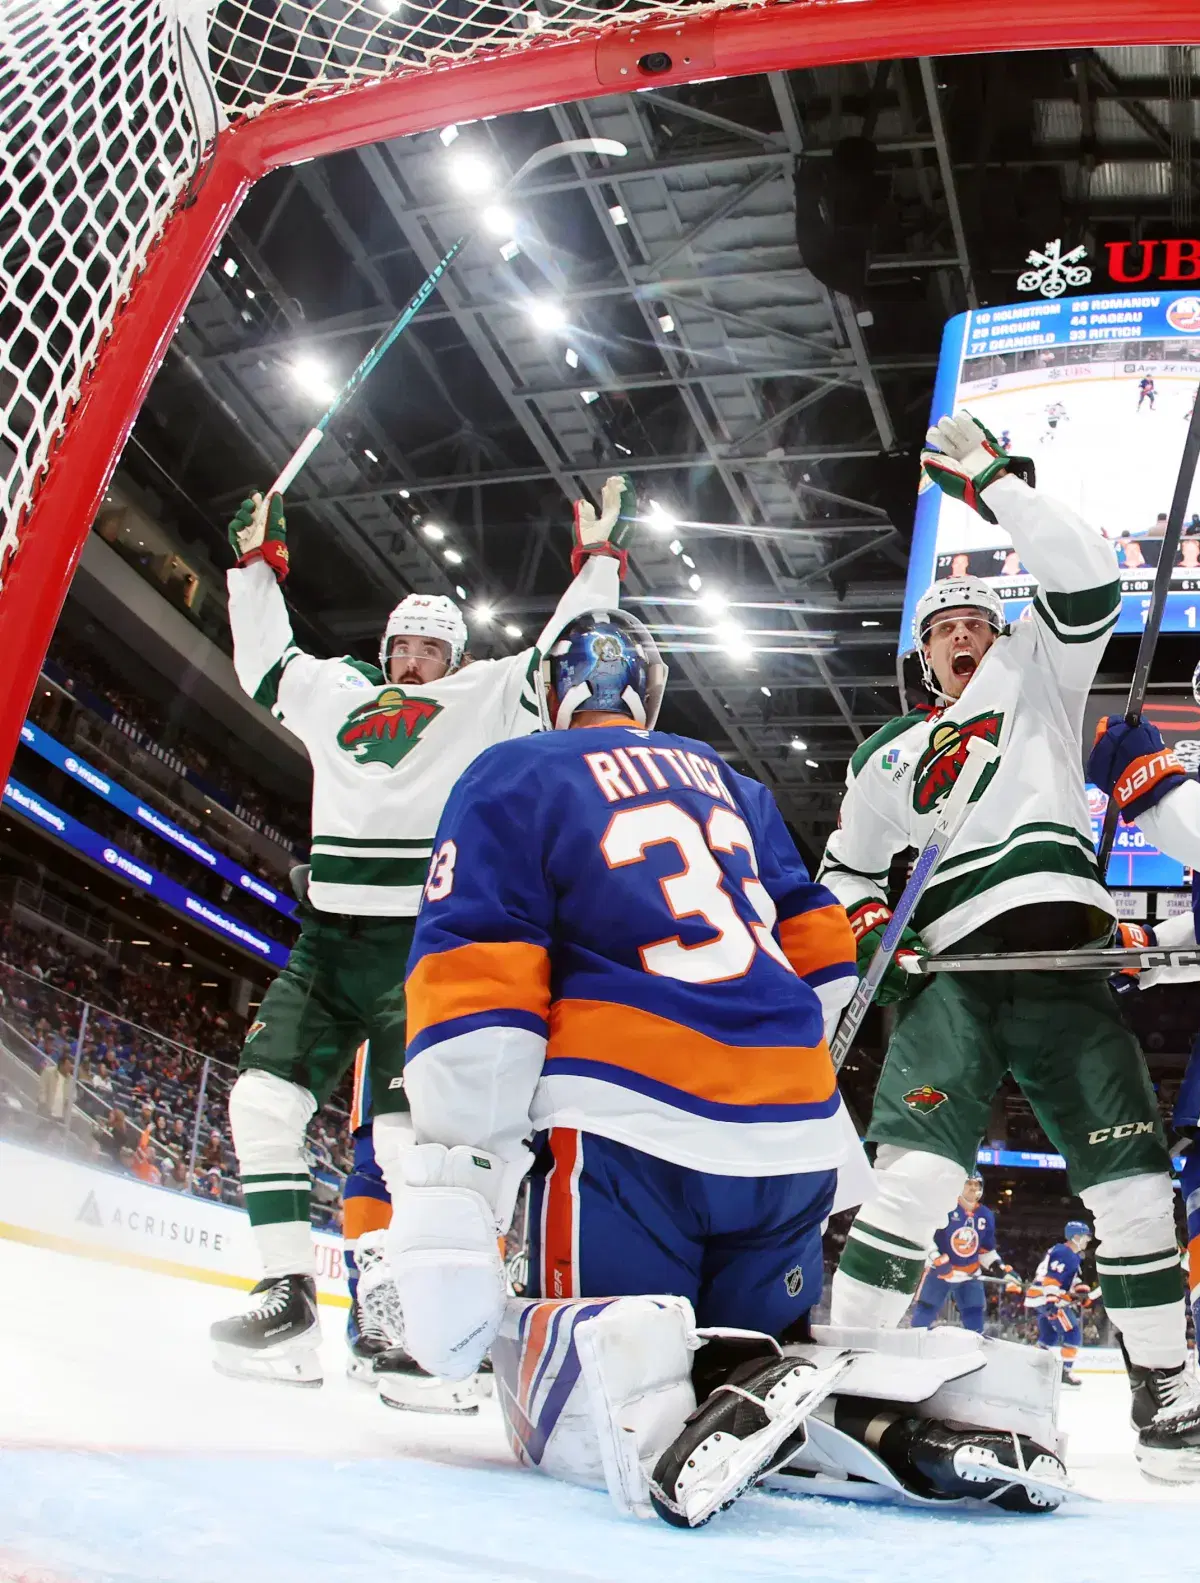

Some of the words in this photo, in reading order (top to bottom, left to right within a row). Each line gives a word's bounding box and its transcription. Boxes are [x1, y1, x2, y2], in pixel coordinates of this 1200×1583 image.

[1091, 297, 1160, 311] ROMANOV
[1070, 315, 1087, 326] 44
[1089, 326, 1142, 339] RITTICH
[971, 342, 987, 354] 77
[989, 332, 1056, 351] DEANGELO
[938, 557, 950, 567] 27
[939, 586, 971, 595] CCM
[1000, 587, 1031, 597] 10:32
[1121, 581, 1149, 590] 6:00
[892, 762, 910, 785] TRIA
[1118, 753, 1181, 802] AUER
[600, 800, 801, 985] 33
[851, 907, 889, 938] CM
[830, 977, 873, 1065] AUER
[1088, 1121, 1155, 1145] CCM
[111, 1208, 224, 1252] ACRISURE
[977, 1218, 986, 1230] C
[314, 1244, 344, 1280] UB
[1051, 1260, 1066, 1274] 44
